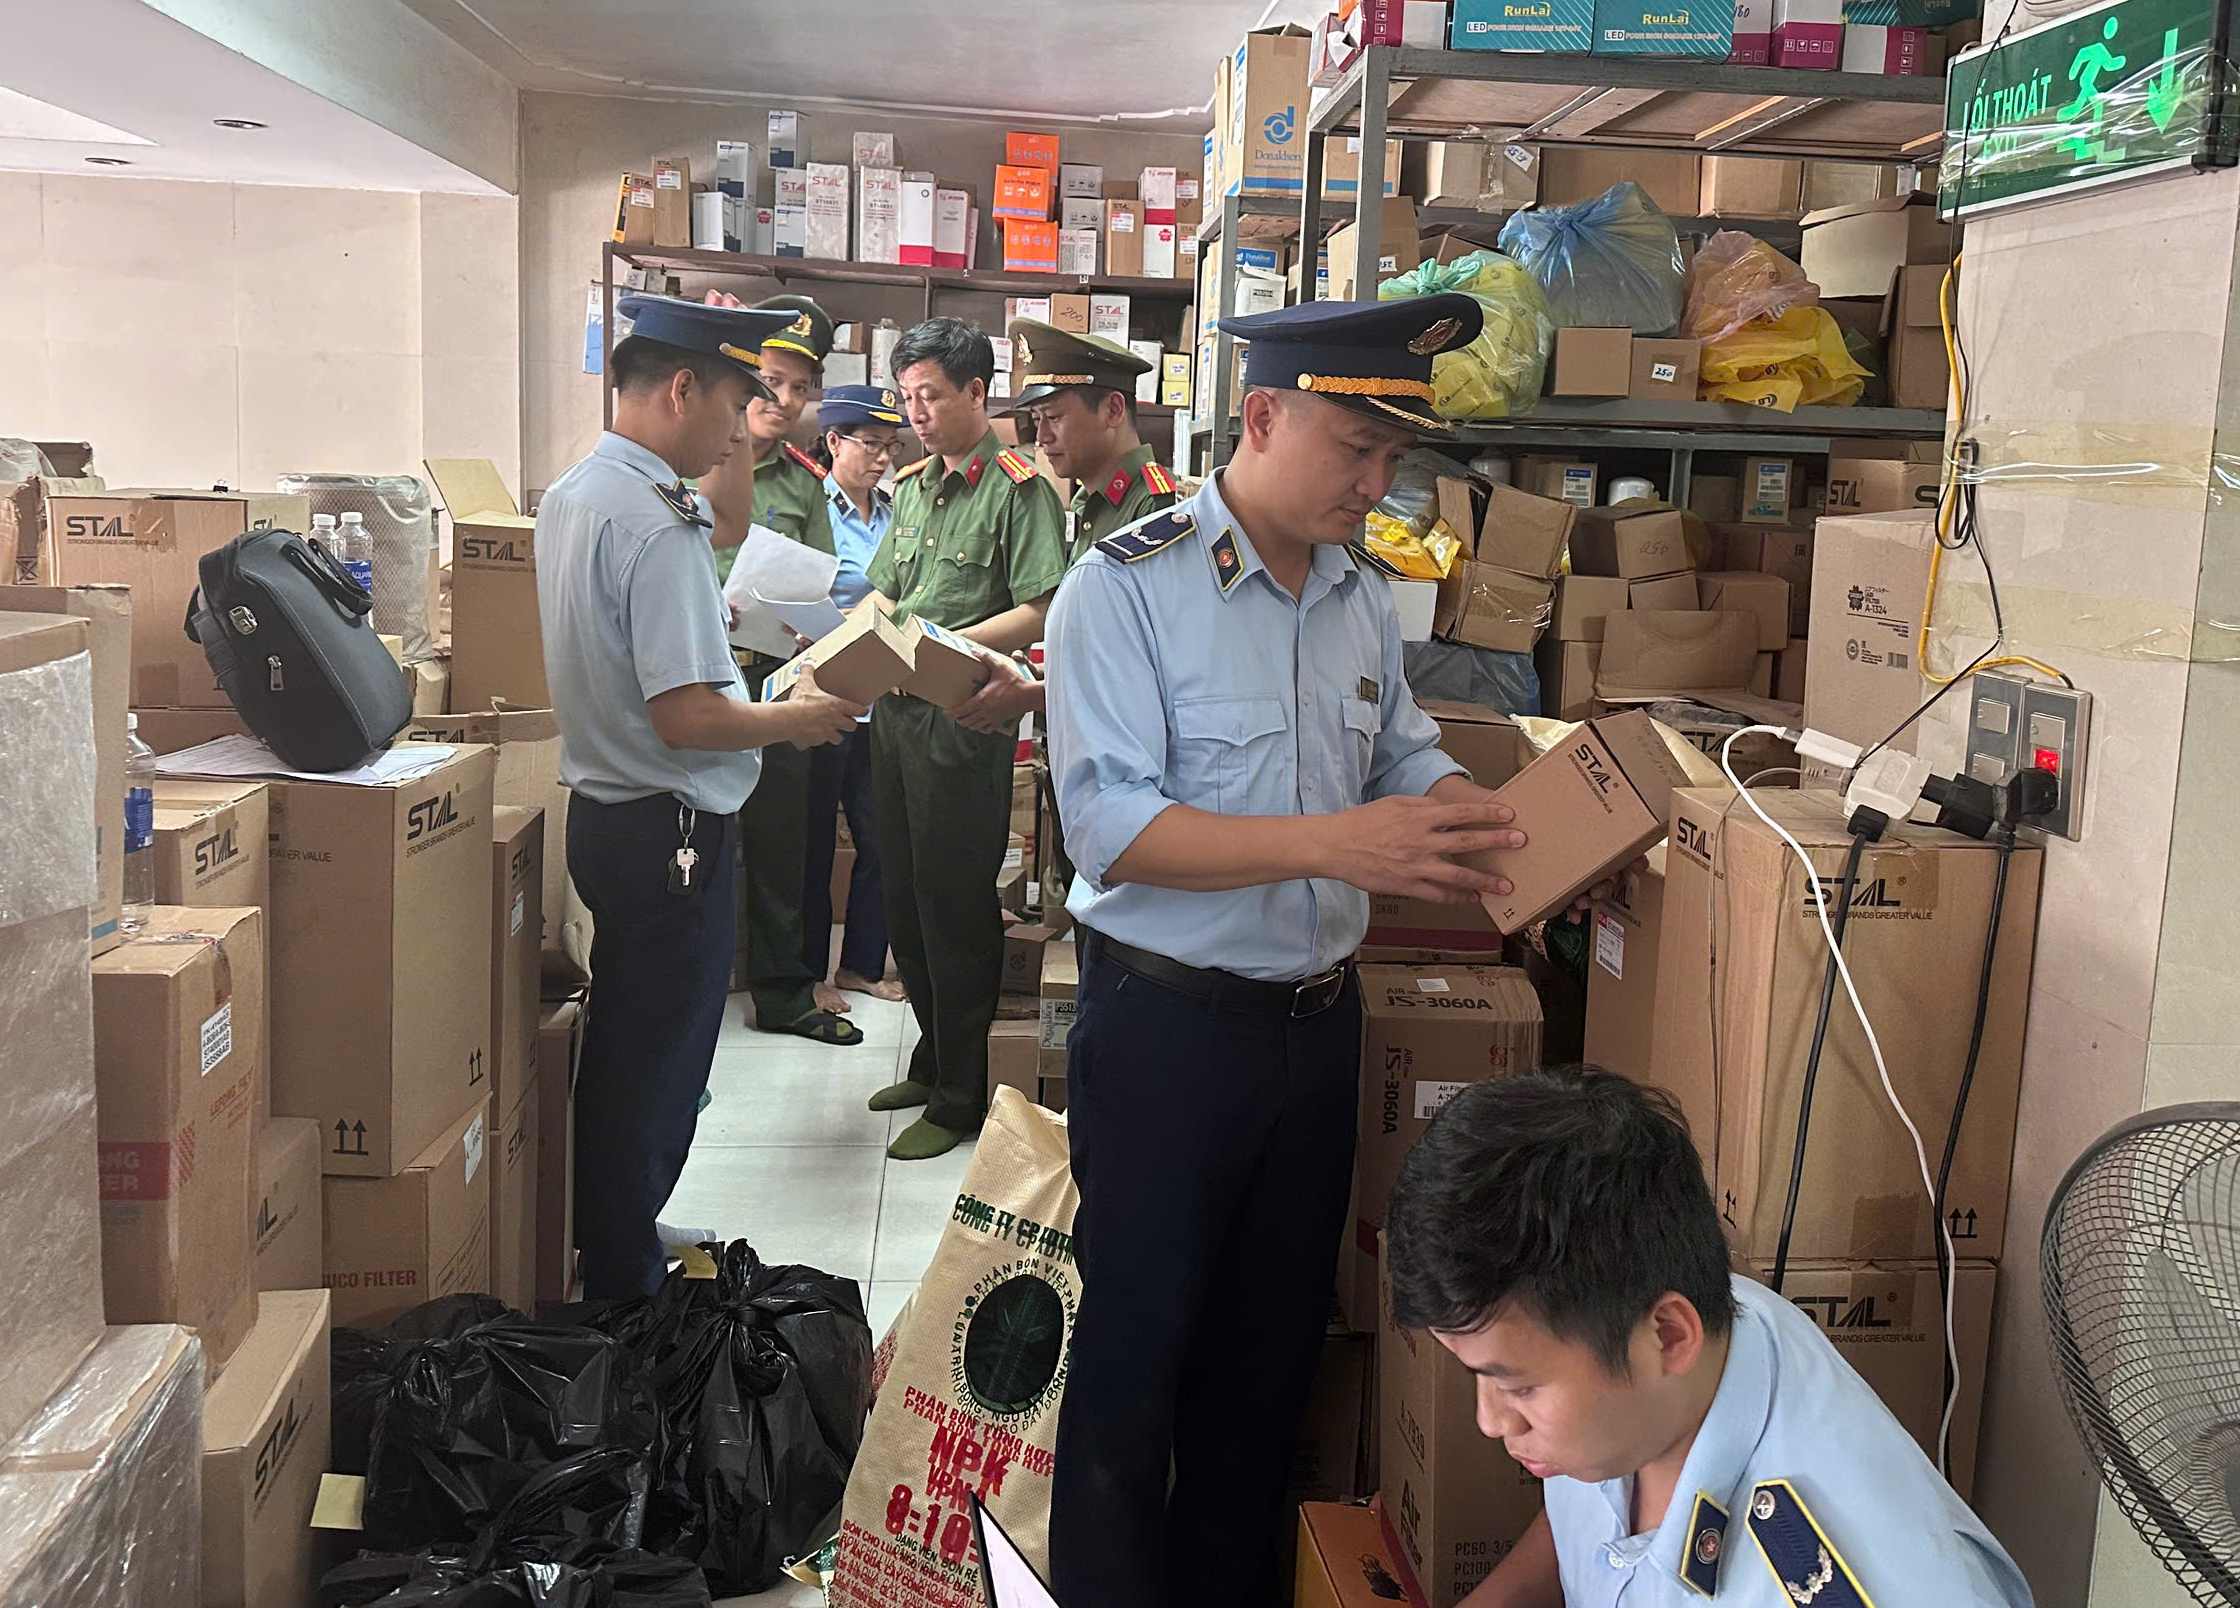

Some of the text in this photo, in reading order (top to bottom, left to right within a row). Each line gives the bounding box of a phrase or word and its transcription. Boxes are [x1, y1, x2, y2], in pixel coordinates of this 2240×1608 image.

[1468, 23, 1487, 32] LED
[1606, 31, 1624, 40] LED
[1994, 68, 2052, 127] THOÁT
[1983, 134, 2021, 159] EXIT
[813, 176, 842, 187] STAL
[866, 180, 896, 191] STAL
[1095, 305, 1124, 315] STAL
[1655, 366, 1673, 377] 250
[1829, 480, 1861, 507] STAL
[67, 516, 134, 537] STAL
[462, 538, 525, 562] STAL
[1575, 743, 1614, 794] STAL
[407, 790, 458, 840] STAL
[1677, 816, 1711, 860] STAL
[195, 828, 238, 876] STAL
[302, 851, 332, 862] VALUE
[1804, 877, 1901, 907] STAL
[1802, 910, 1838, 919] STRNGE
[1876, 911, 1909, 920] GREATER
[1910, 911, 1933, 920] VALUE
[1384, 996, 1493, 1010] JS-3060A
[1382, 1044, 1401, 1135] JS-3060A
[363, 1269, 417, 1288] FILTER
[1791, 1296, 1891, 1327] STAL
[1864, 1334, 1900, 1344] GREATER
[1901, 1333, 1926, 1343] VALUE
[928, 1425, 1012, 1496] NPK
